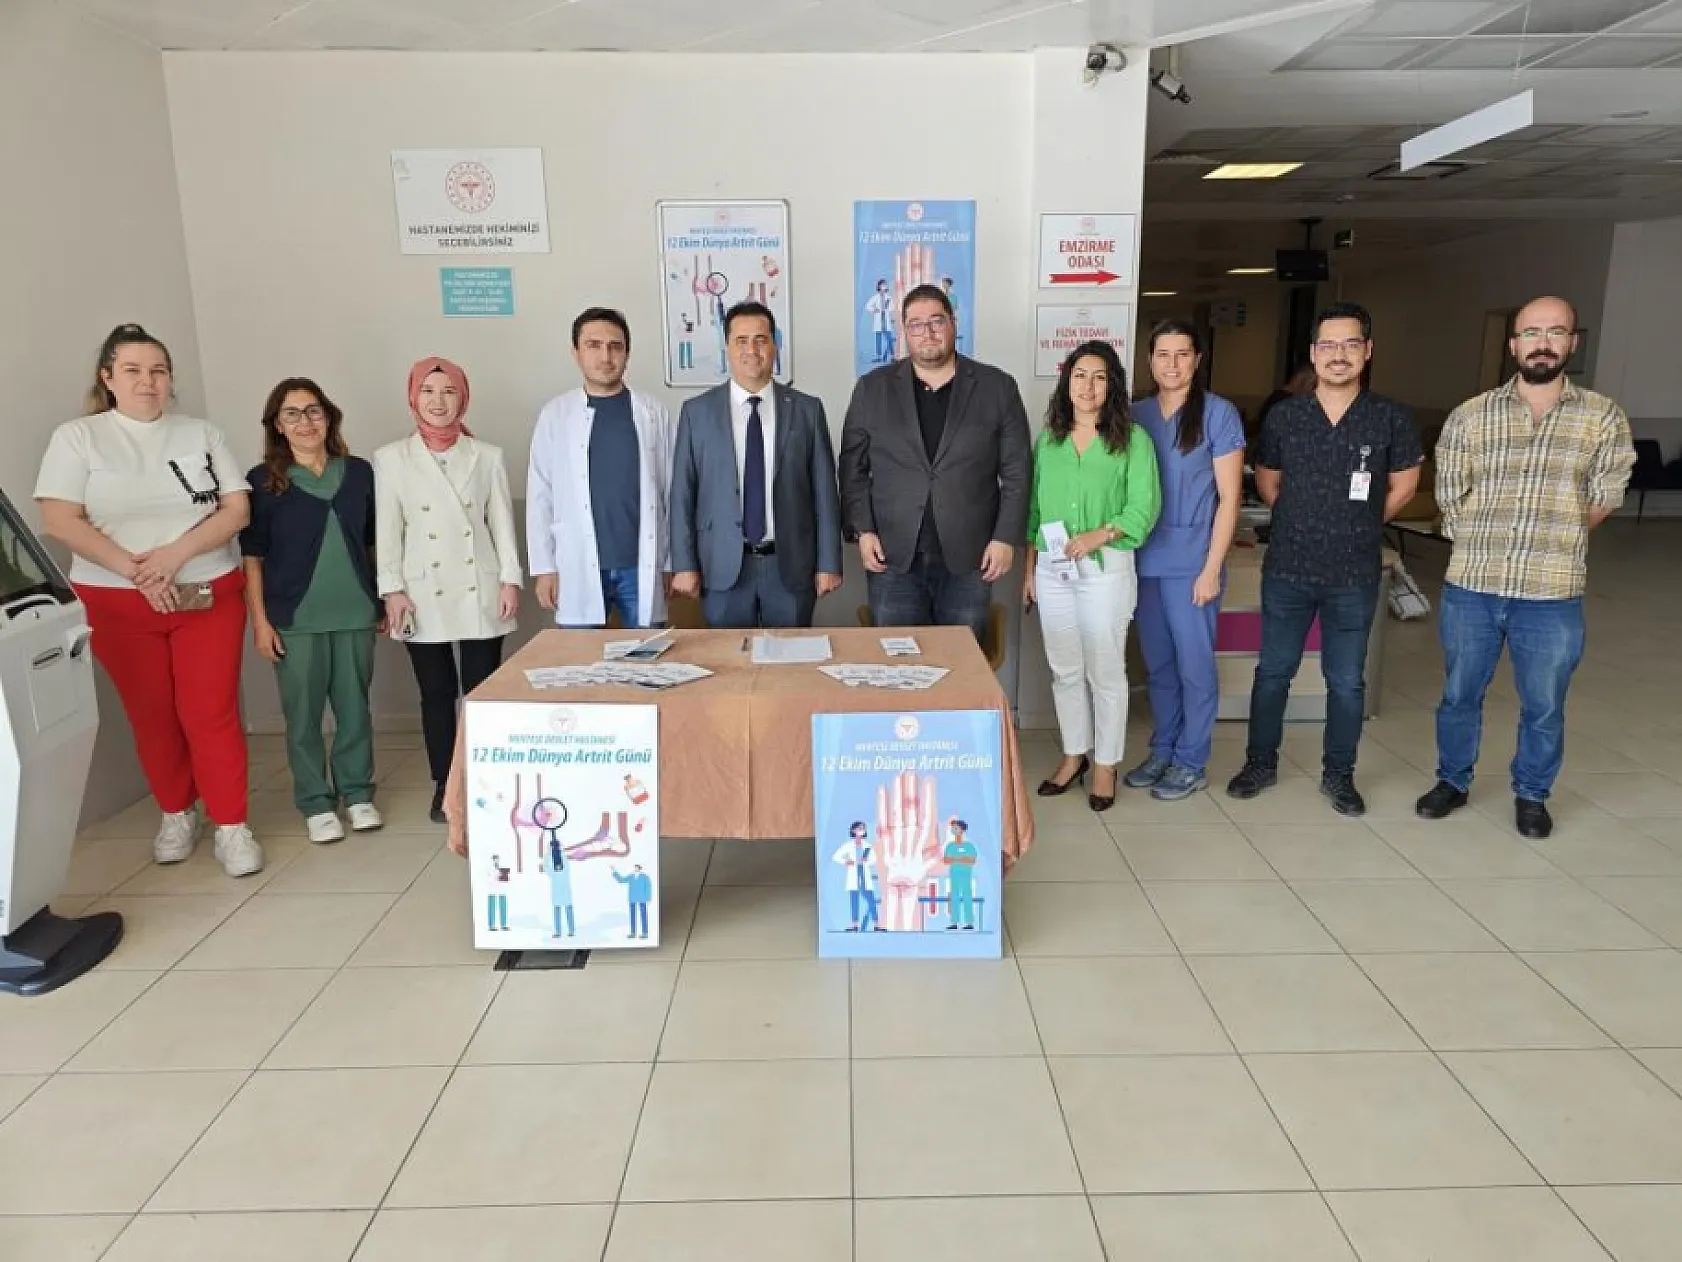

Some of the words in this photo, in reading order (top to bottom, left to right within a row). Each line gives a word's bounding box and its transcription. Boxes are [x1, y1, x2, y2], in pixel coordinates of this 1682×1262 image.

[408, 223, 484, 235] HASTANEMİZDE
[1059, 239, 1116, 253] EMZİRME
[1068, 255, 1105, 268] ODASI
[473, 748, 489, 763] 12
[492, 748, 525, 763] Ekim
[528, 748, 572, 767] Dünya
[574, 748, 613, 763] Artrit
[615, 748, 652, 764] Günü
[821, 756, 838, 771] 12
[840, 756, 872, 771] Ekim
[874, 755, 916, 773] Dünya
[919, 754, 955, 770] Artrit
[958, 754, 993, 768] Günü
